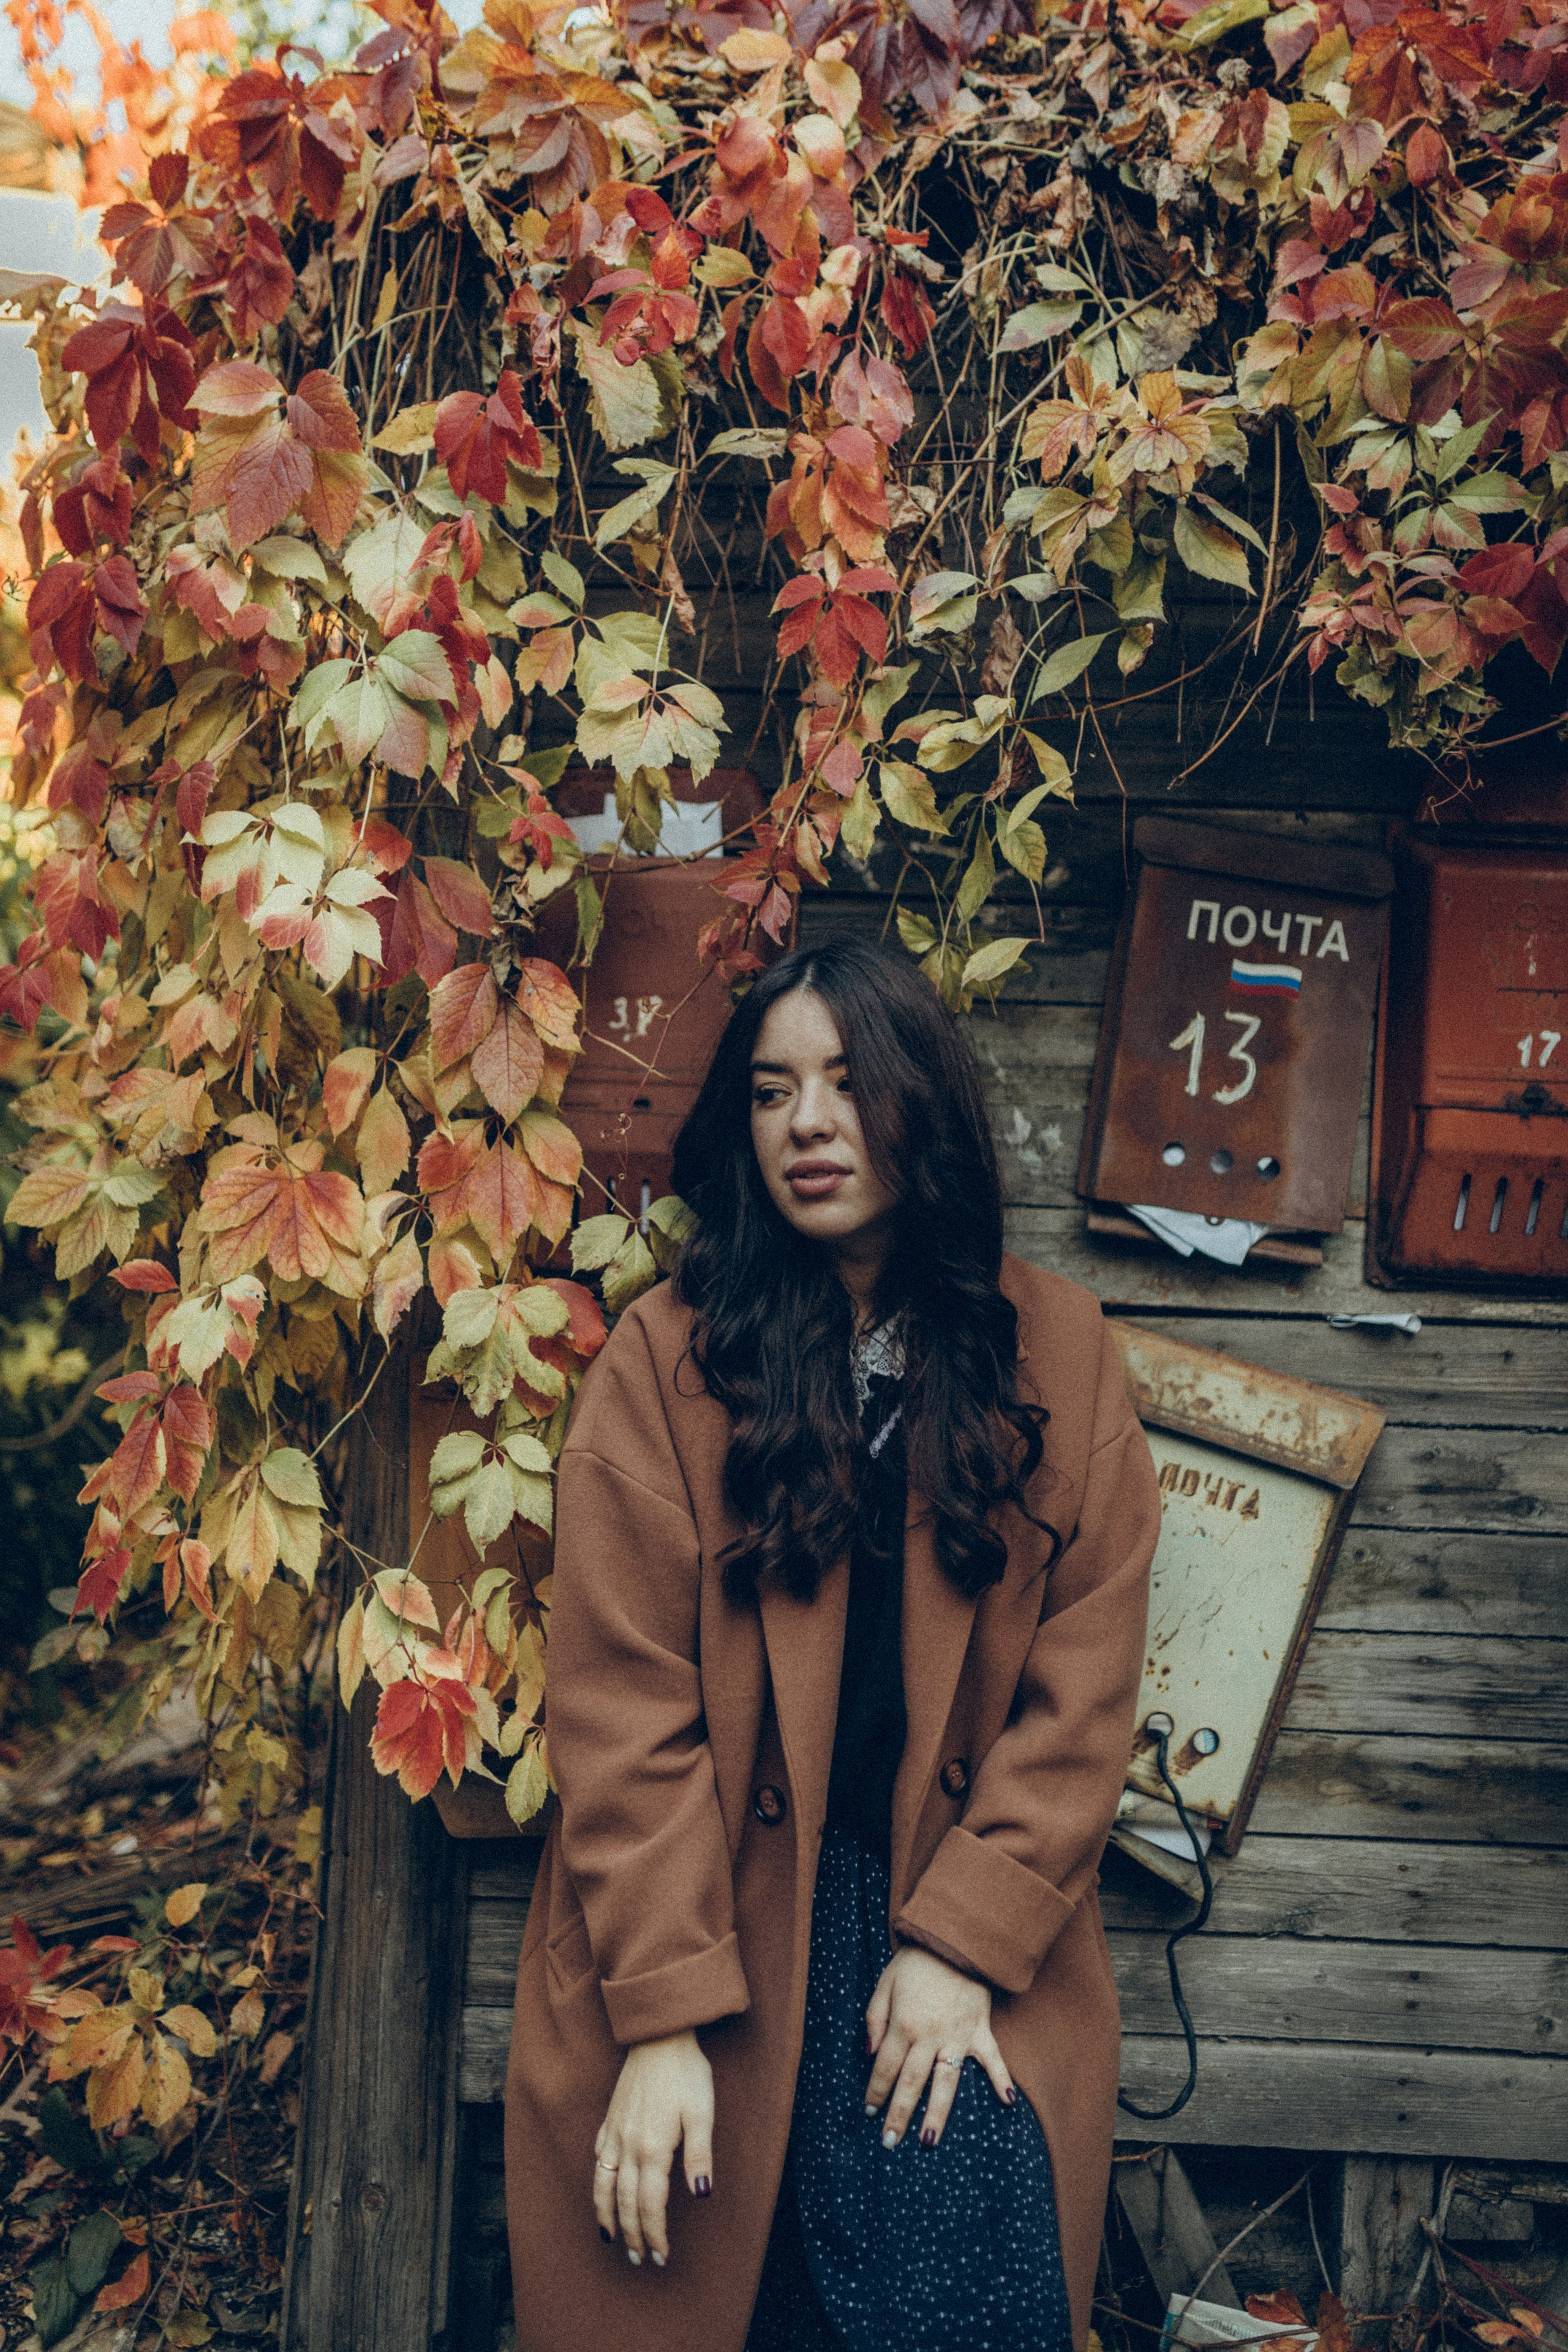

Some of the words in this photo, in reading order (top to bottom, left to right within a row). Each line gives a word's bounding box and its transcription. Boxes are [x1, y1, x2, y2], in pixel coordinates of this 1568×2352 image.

[1187, 899, 1350, 962] ПОЧТА
[1168, 1011, 1262, 1104] 13
[1517, 1030, 1561, 1068] 17
[1159, 1463, 1260, 1520] ПОЧТА
